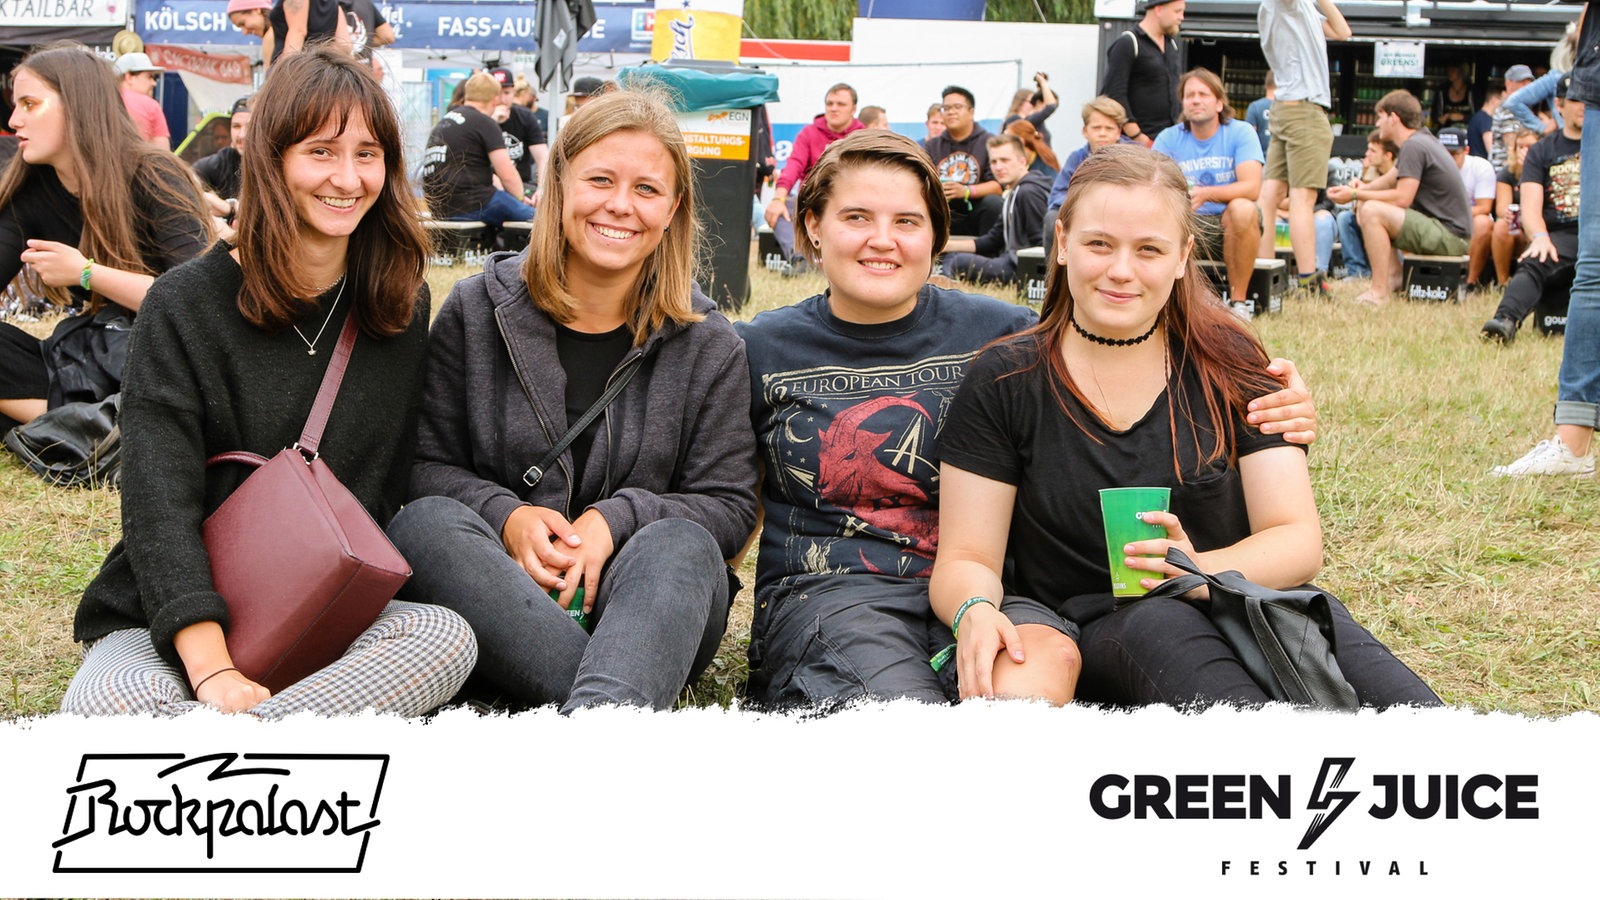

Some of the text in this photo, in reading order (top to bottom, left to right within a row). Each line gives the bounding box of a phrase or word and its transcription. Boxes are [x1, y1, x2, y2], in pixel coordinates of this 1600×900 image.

[144, 6, 227, 31] KÖLSCH
[728, 112, 749, 121] EGN
[792, 365, 966, 394] EUROPEAN TOUR
